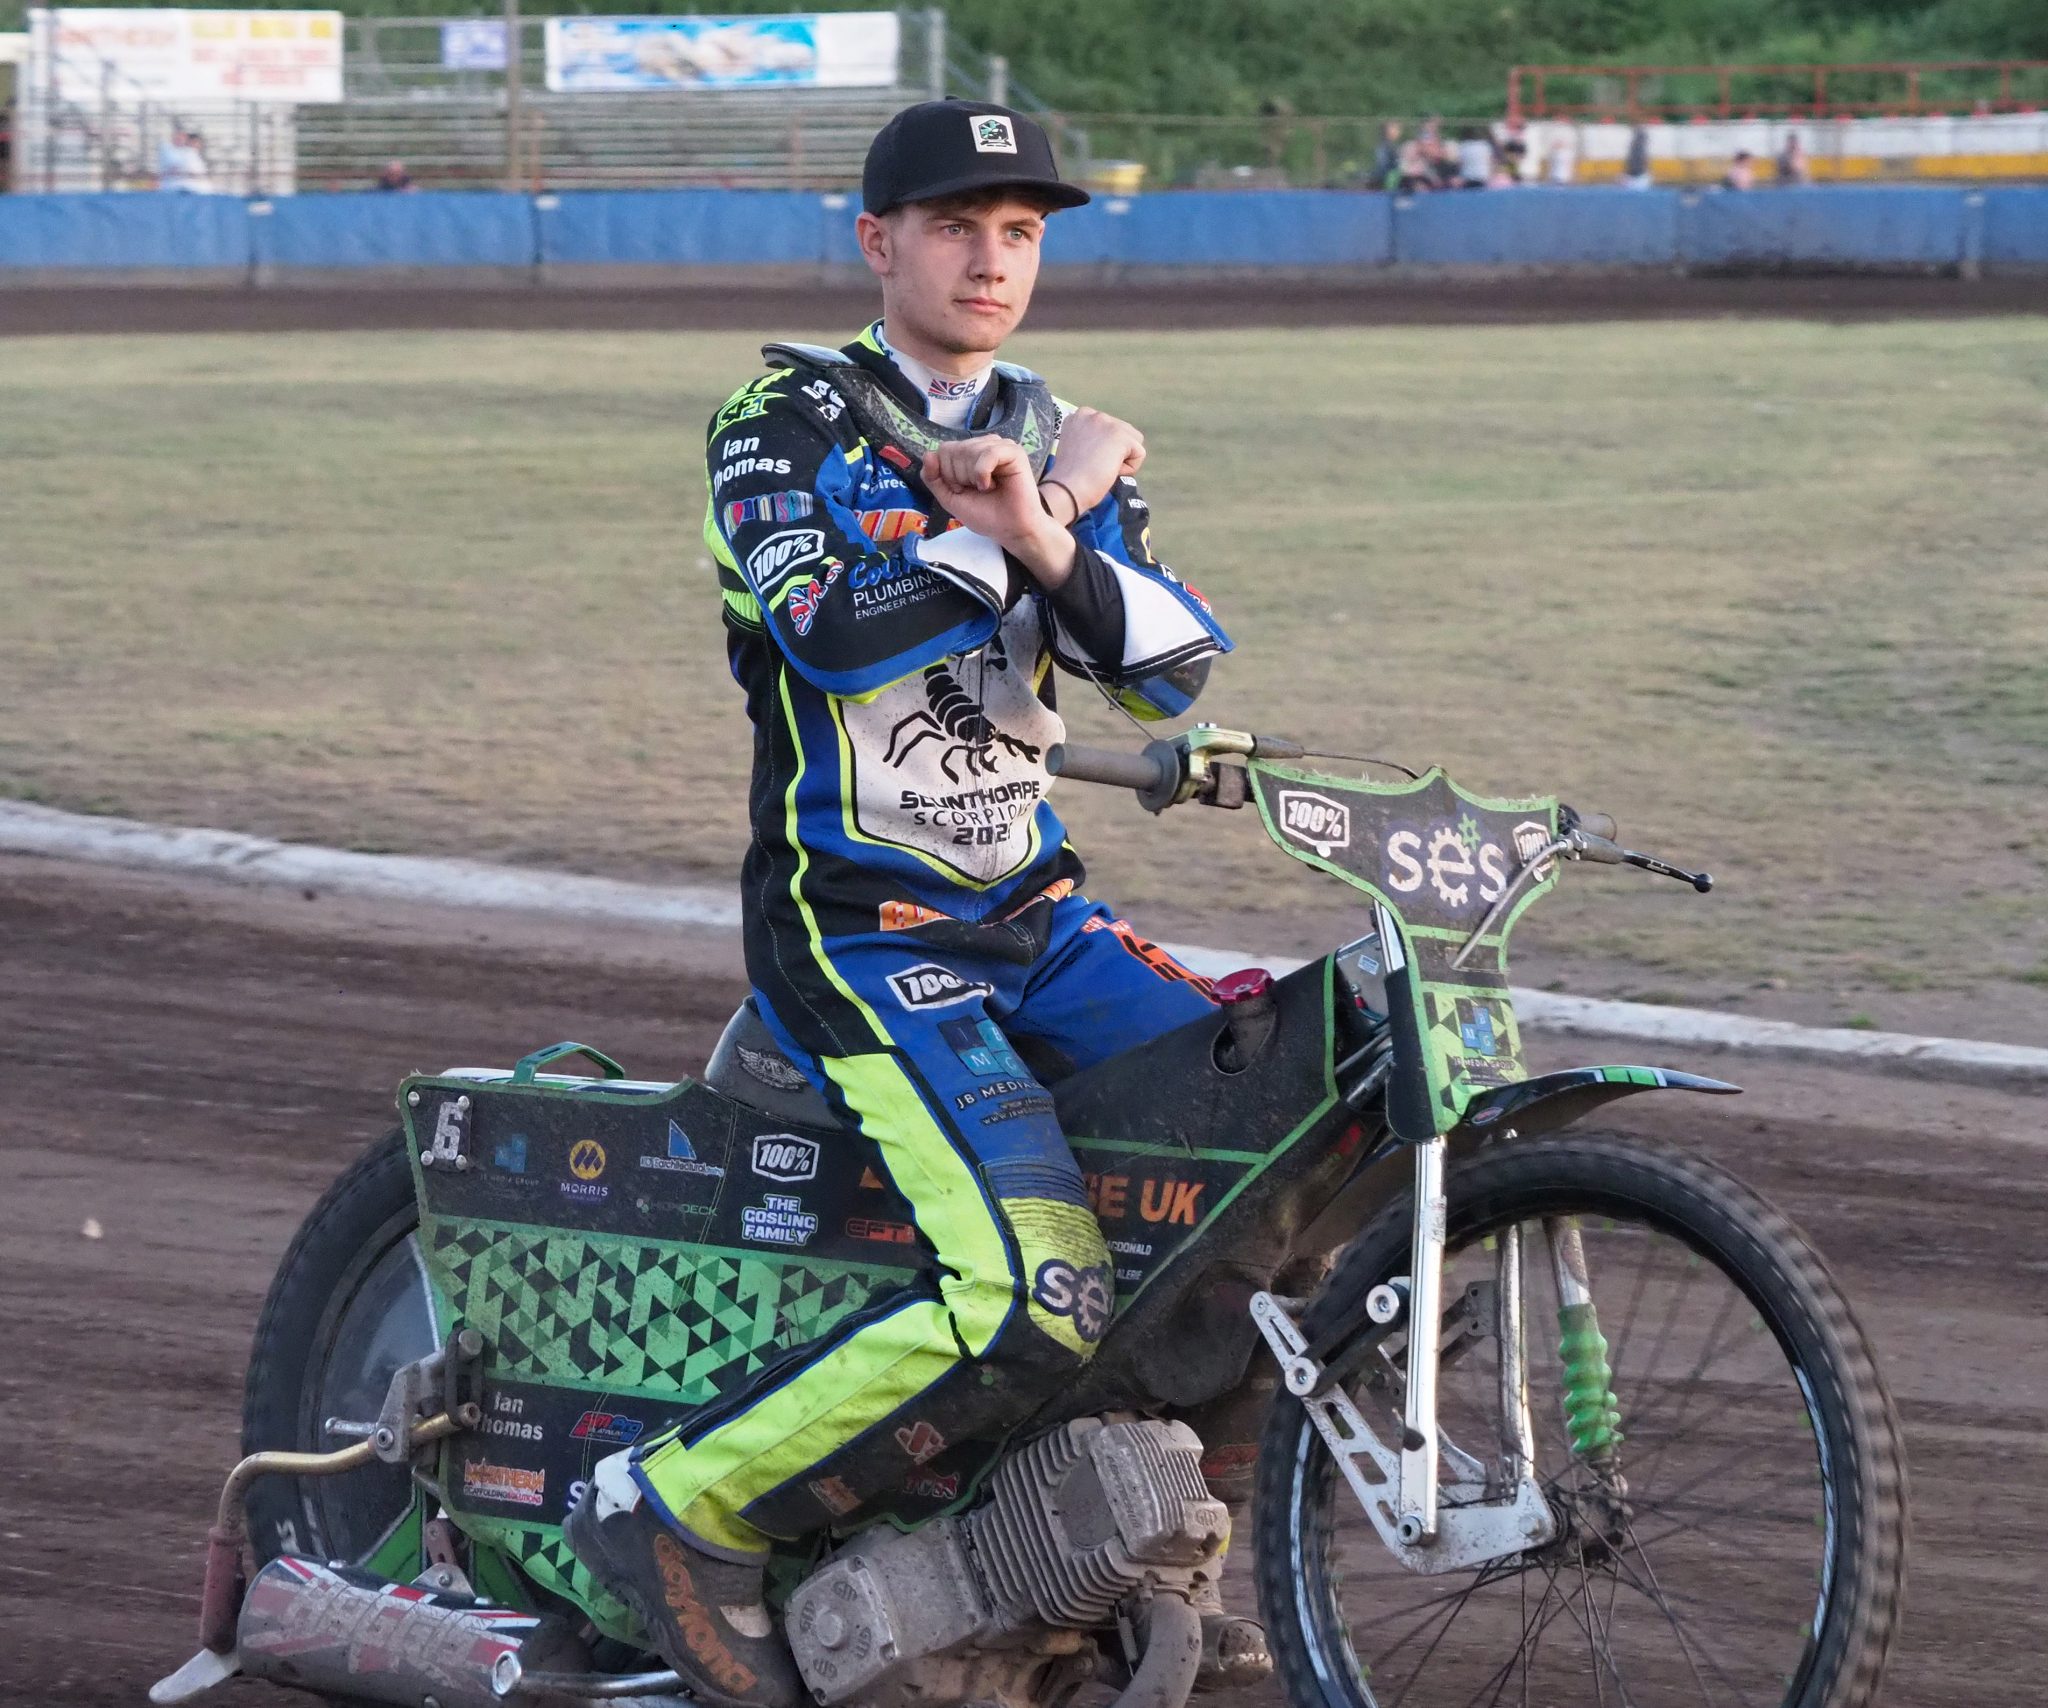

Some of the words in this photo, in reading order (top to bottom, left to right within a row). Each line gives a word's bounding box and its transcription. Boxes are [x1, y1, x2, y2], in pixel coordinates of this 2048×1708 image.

[753, 534, 814, 584] 100%
[855, 597, 907, 620] ENGINEER
[900, 781, 1040, 810] SCUNTHORPE
[1288, 800, 1342, 838] 100%
[956, 1093, 976, 1110] JB
[431, 1101, 464, 1161] 6
[759, 1143, 812, 1172] 100%
[560, 1182, 609, 1197] MORRIS
[1140, 1179, 1206, 1226] UK
[766, 1196, 799, 1212] THE
[744, 1209, 816, 1229] GOSLING
[745, 1224, 808, 1243] FAMILY
